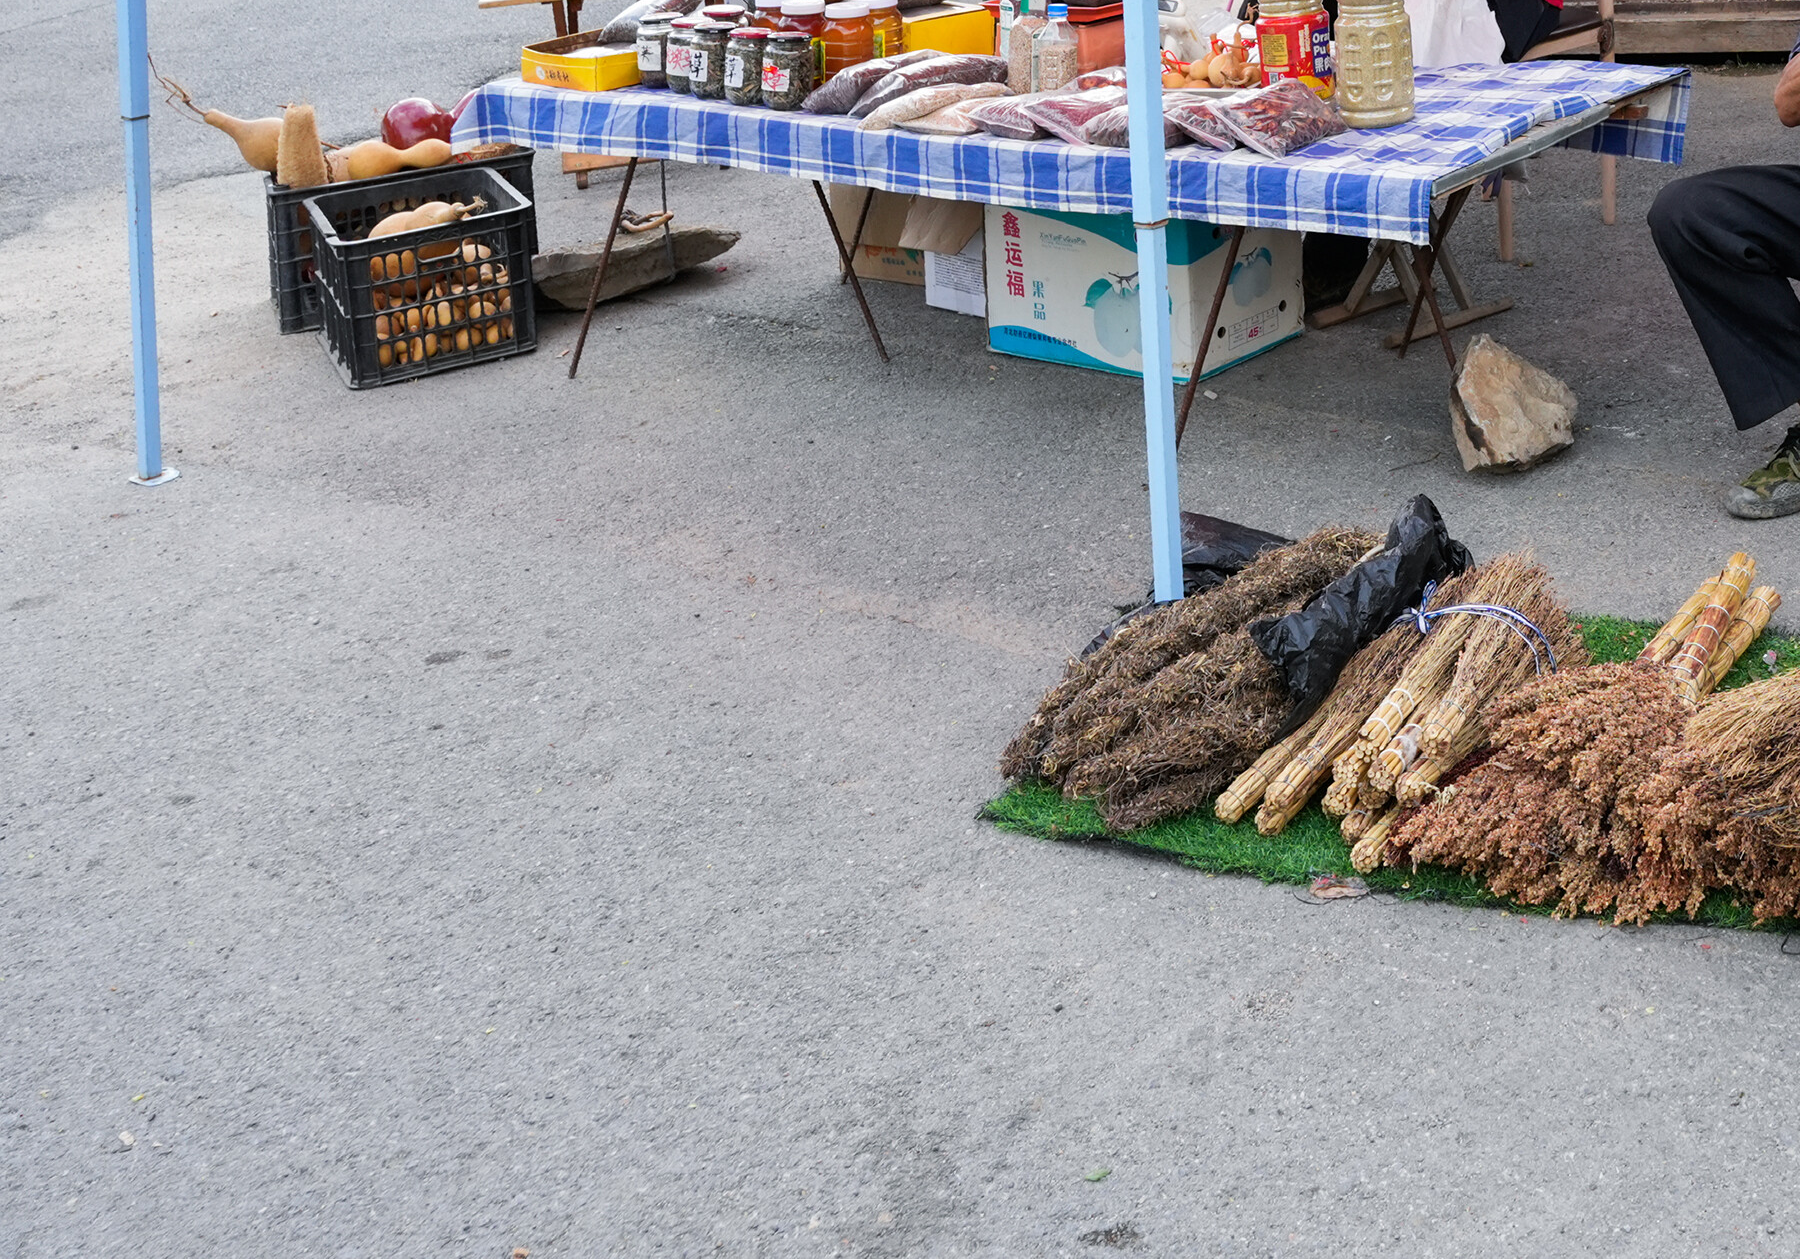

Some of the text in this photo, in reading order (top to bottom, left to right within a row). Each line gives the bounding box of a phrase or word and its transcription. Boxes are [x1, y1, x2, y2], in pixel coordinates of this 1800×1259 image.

[1001, 211, 1025, 298] 鑫运福
[1032, 279, 1046, 321] 果品
[1248, 326, 1259, 338] 45
